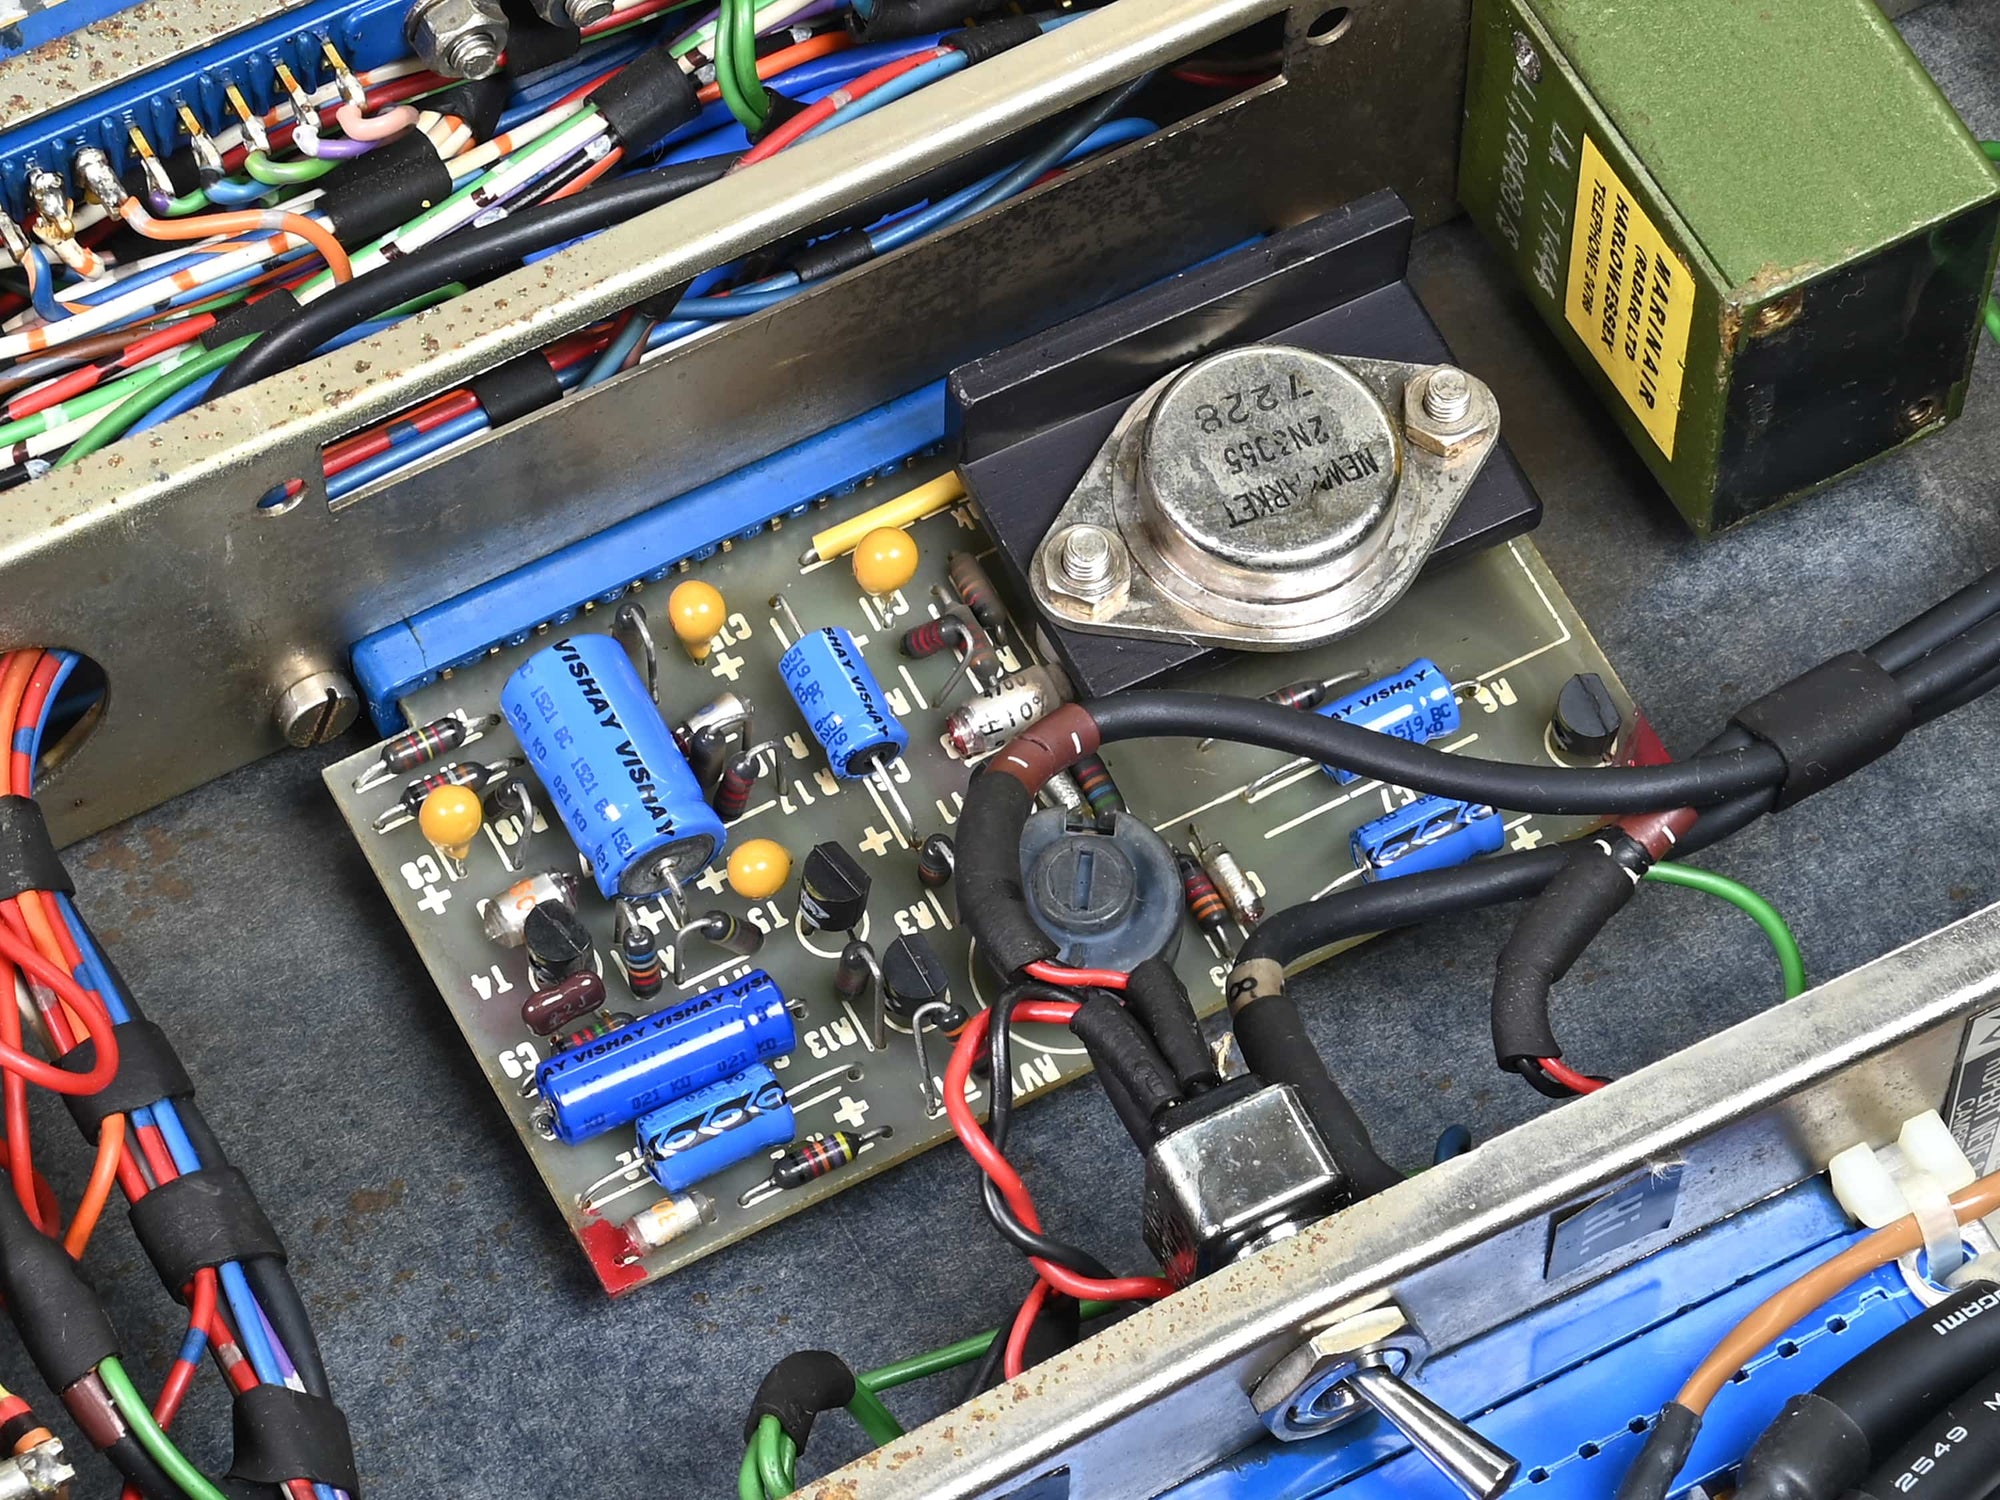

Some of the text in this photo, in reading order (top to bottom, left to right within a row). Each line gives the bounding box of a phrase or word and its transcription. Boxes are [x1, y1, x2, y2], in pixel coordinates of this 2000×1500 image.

[1586, 178, 1606, 276] TELEPHONE
[1601, 193, 1630, 353] HARLOW ESSEX
[1624, 244, 1648, 361] (RADAR) LTD
[1639, 252, 1671, 409] MARINAIR
[1194, 373, 1315, 434] 7228
[852, 676, 889, 738] VISHAY
[1360, 669, 1428, 709] VISHAY
[1430, 702, 1451, 721] BC
[553, 639, 676, 837] VISHAY VISHAY
[530, 685, 559, 724] 1521
[554, 725, 573, 750] BC
[571, 757, 599, 796] 1521
[611, 827, 638, 862] 1521
[401, 856, 441, 890] C8
[746, 900, 789, 935] T5
[893, 900, 936, 936] R3
[470, 964, 514, 1000] T4
[572, 1026, 647, 1063] VISHAY
[652, 991, 726, 1030] VISHAY
[803, 1016, 858, 1060] R13
[498, 1041, 542, 1079] C9
[1974, 1058, 2000, 1121] RUPERT
[1965, 1117, 1999, 1168] NEVE
[1895, 1424, 1970, 1494] 2549
